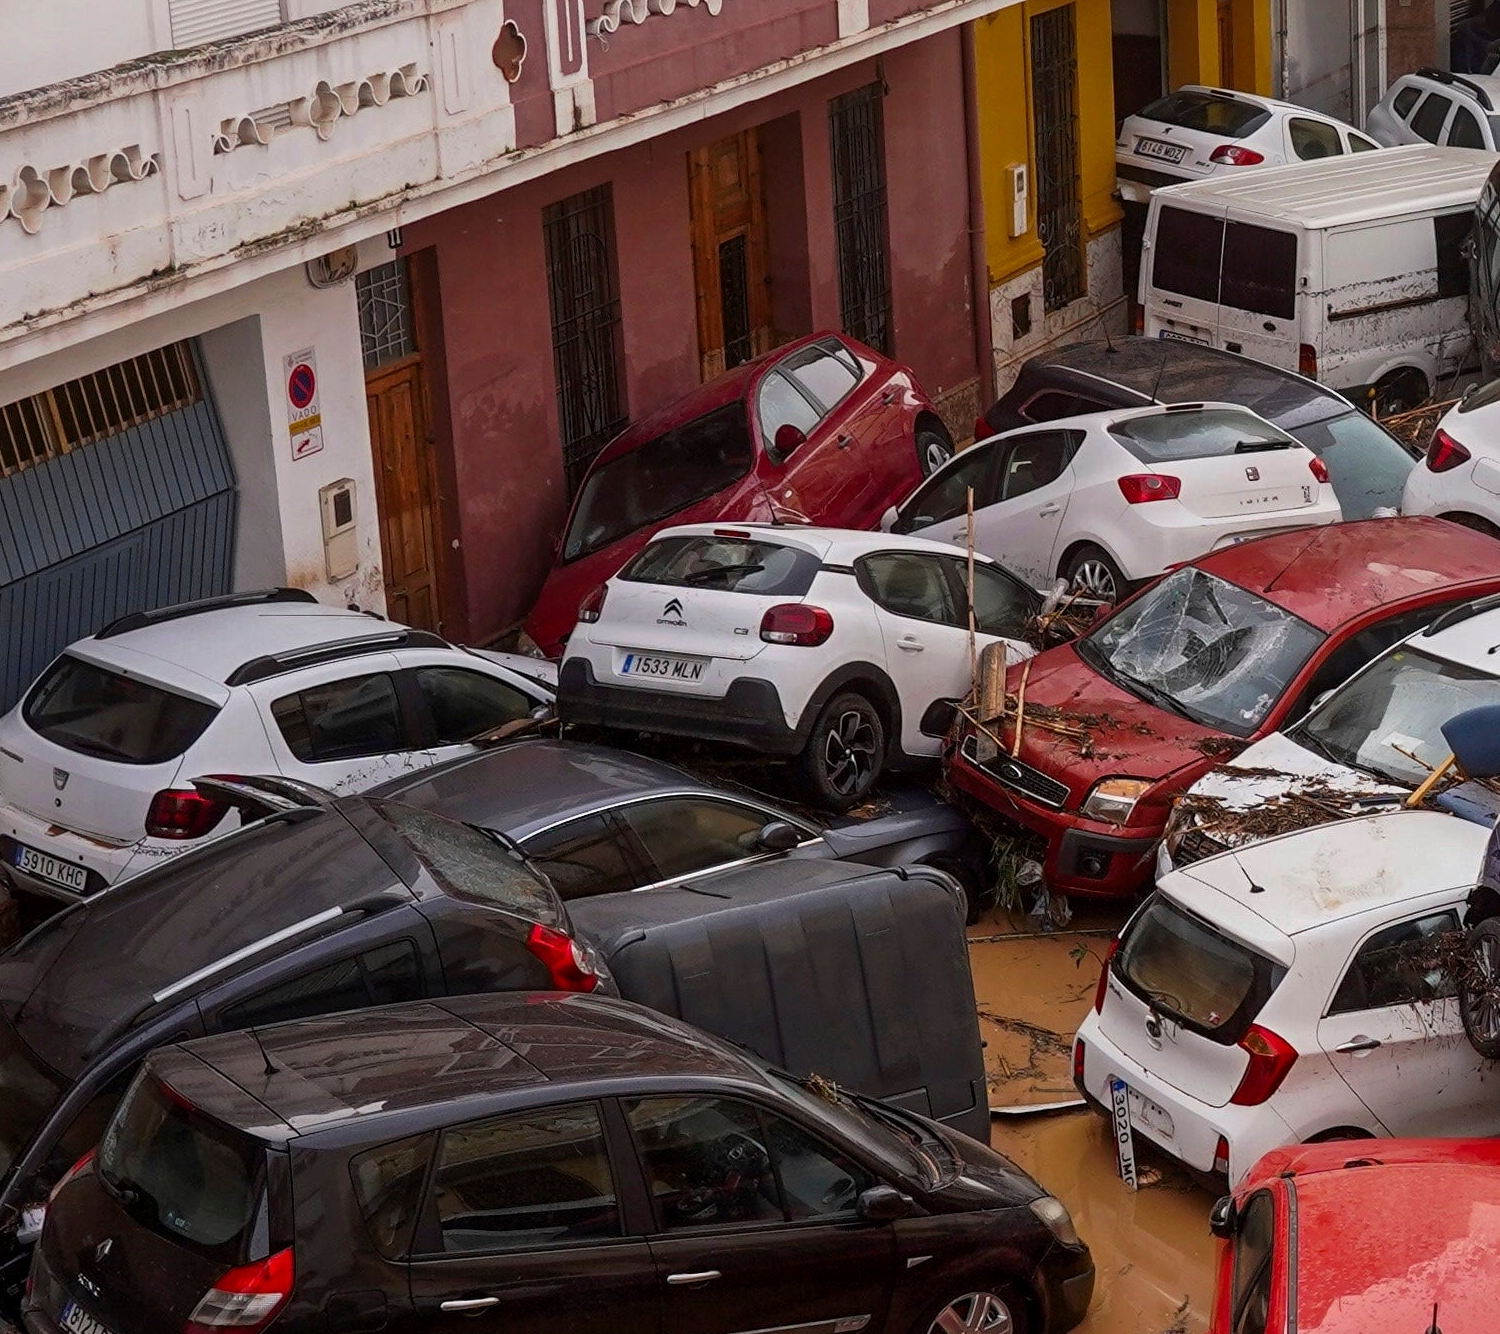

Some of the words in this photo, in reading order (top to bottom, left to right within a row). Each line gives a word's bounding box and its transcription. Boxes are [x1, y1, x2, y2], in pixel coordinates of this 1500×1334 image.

[292, 405, 317, 422] VADO
[734, 627, 749, 635] C3
[634, 656, 670, 675] 1533
[672, 661, 703, 680] MLN
[23, 850, 54, 876] 5910
[58, 861, 84, 886] KHC
[1115, 1094, 1130, 1144] 3020
